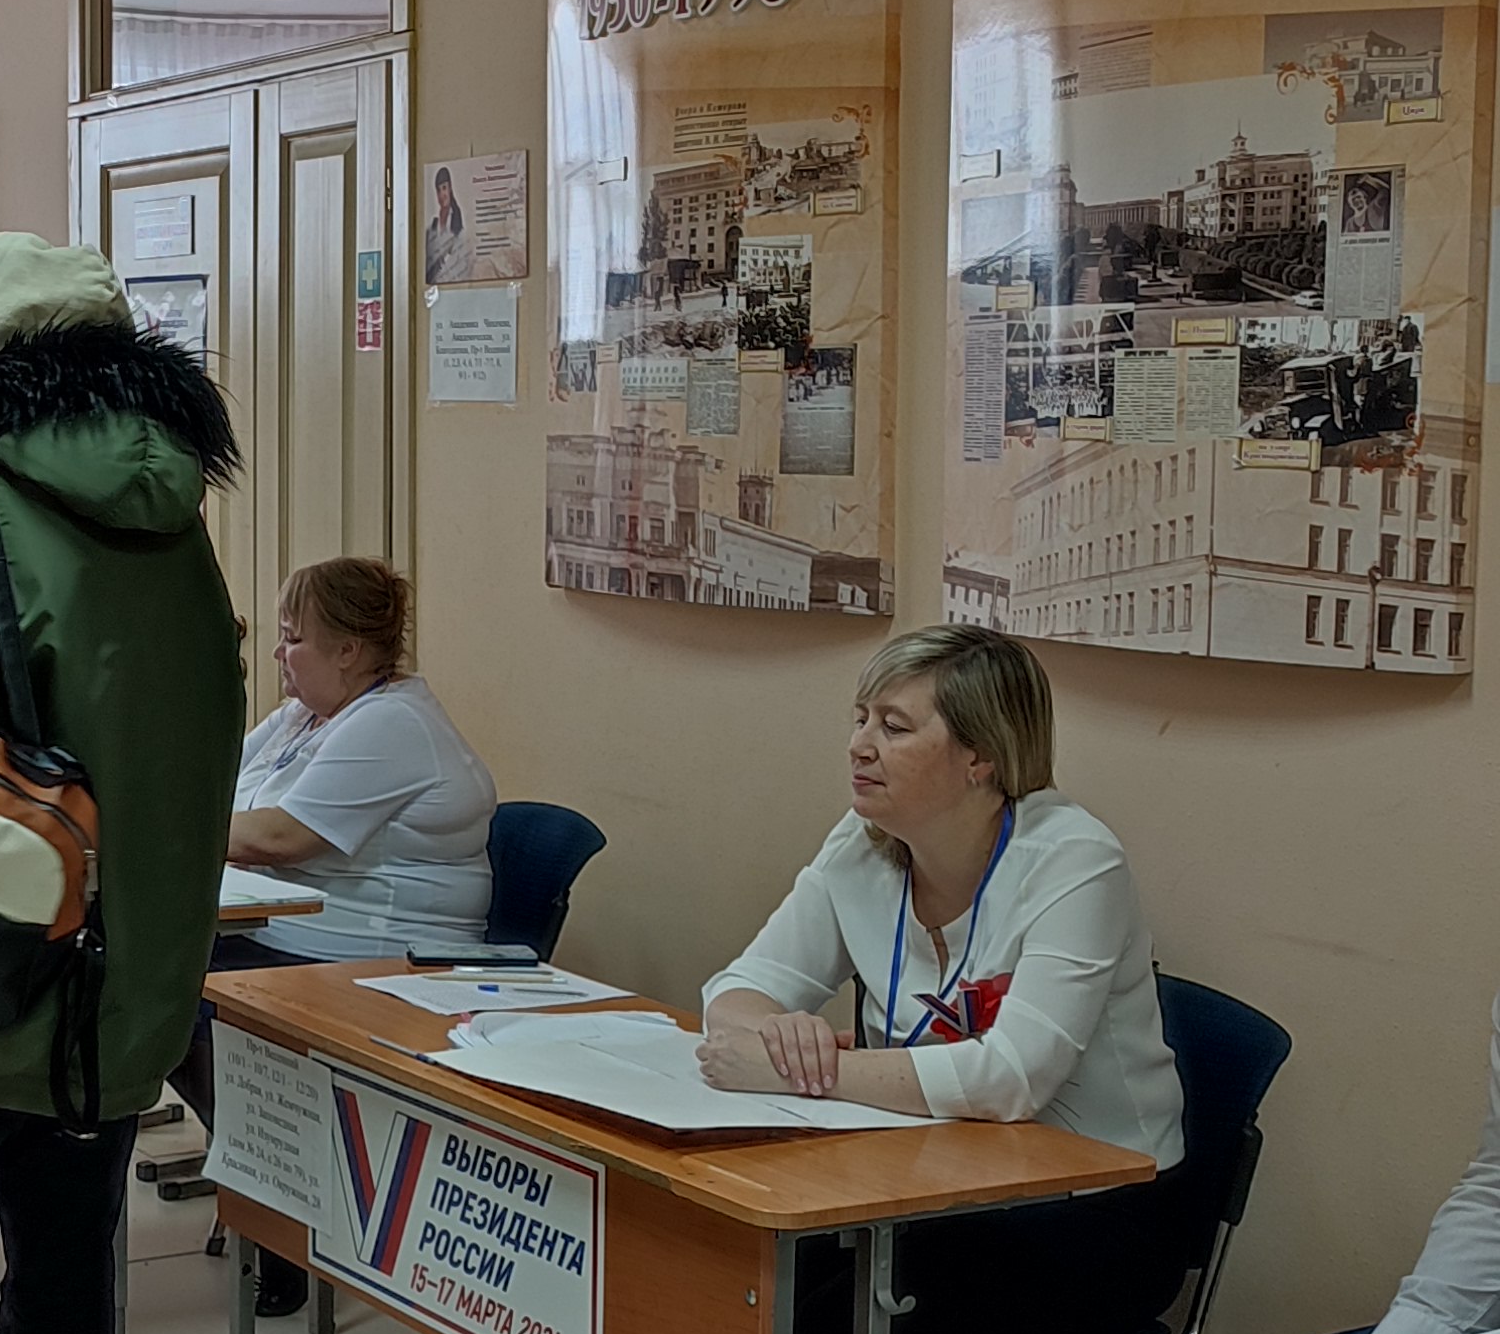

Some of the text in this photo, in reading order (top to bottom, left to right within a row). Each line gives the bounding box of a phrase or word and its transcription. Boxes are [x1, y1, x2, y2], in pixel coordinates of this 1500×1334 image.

[441, 1133, 553, 1207] ВЫБОРЫ
[418, 1220, 515, 1293] РОССИИ
[430, 1177, 586, 1277] ПРЕЗИДЕНТА
